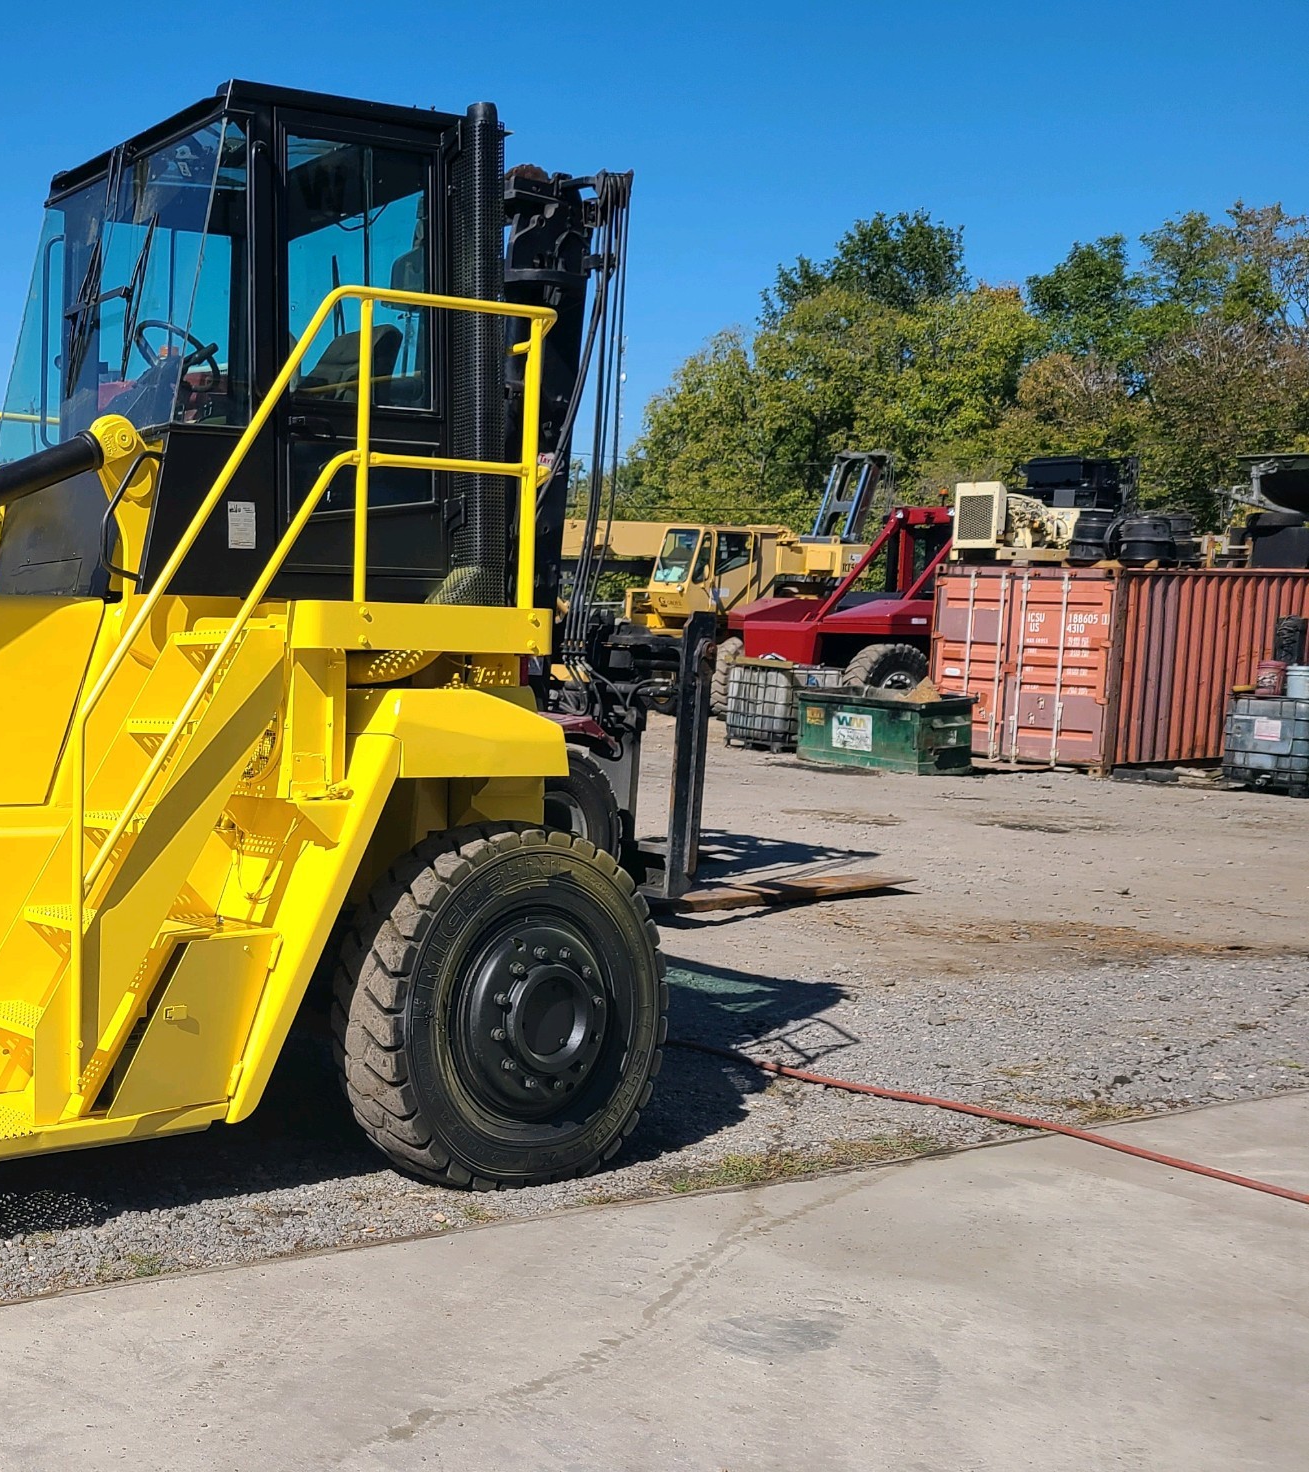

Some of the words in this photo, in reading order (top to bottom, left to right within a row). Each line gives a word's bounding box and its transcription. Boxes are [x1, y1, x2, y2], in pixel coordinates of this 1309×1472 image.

[1028, 613, 1045, 622] ICSU
[1069, 614, 1098, 624] 188605
[1030, 623, 1039, 632] US
[1066, 624, 1084, 633] 4310
